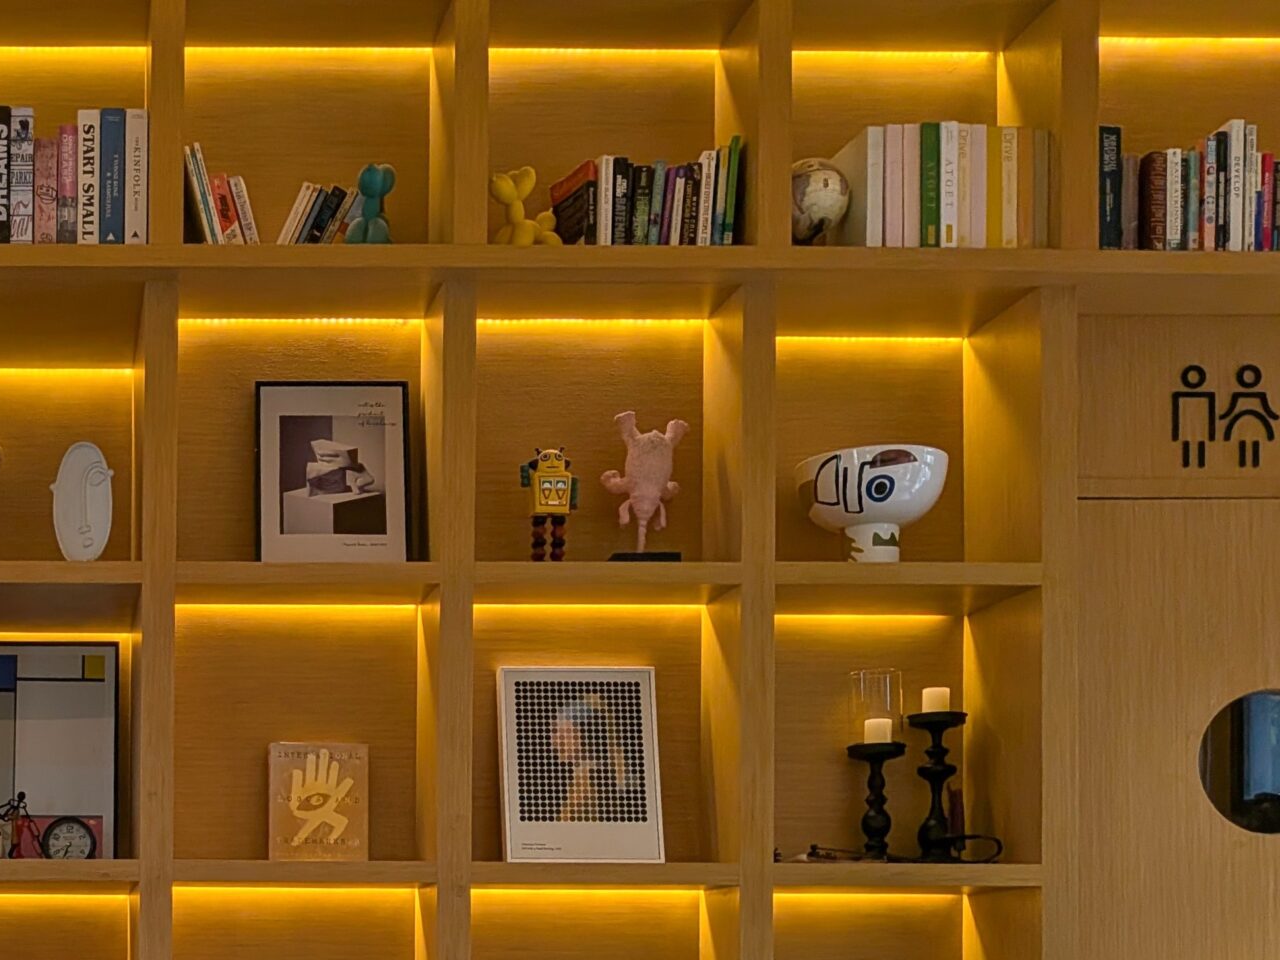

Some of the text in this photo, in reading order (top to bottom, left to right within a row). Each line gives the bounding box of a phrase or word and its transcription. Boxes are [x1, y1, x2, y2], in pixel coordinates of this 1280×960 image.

[959, 130, 969, 159] Drive
[1003, 133, 1014, 162] Drive
[82, 124, 95, 240] START SMALL
